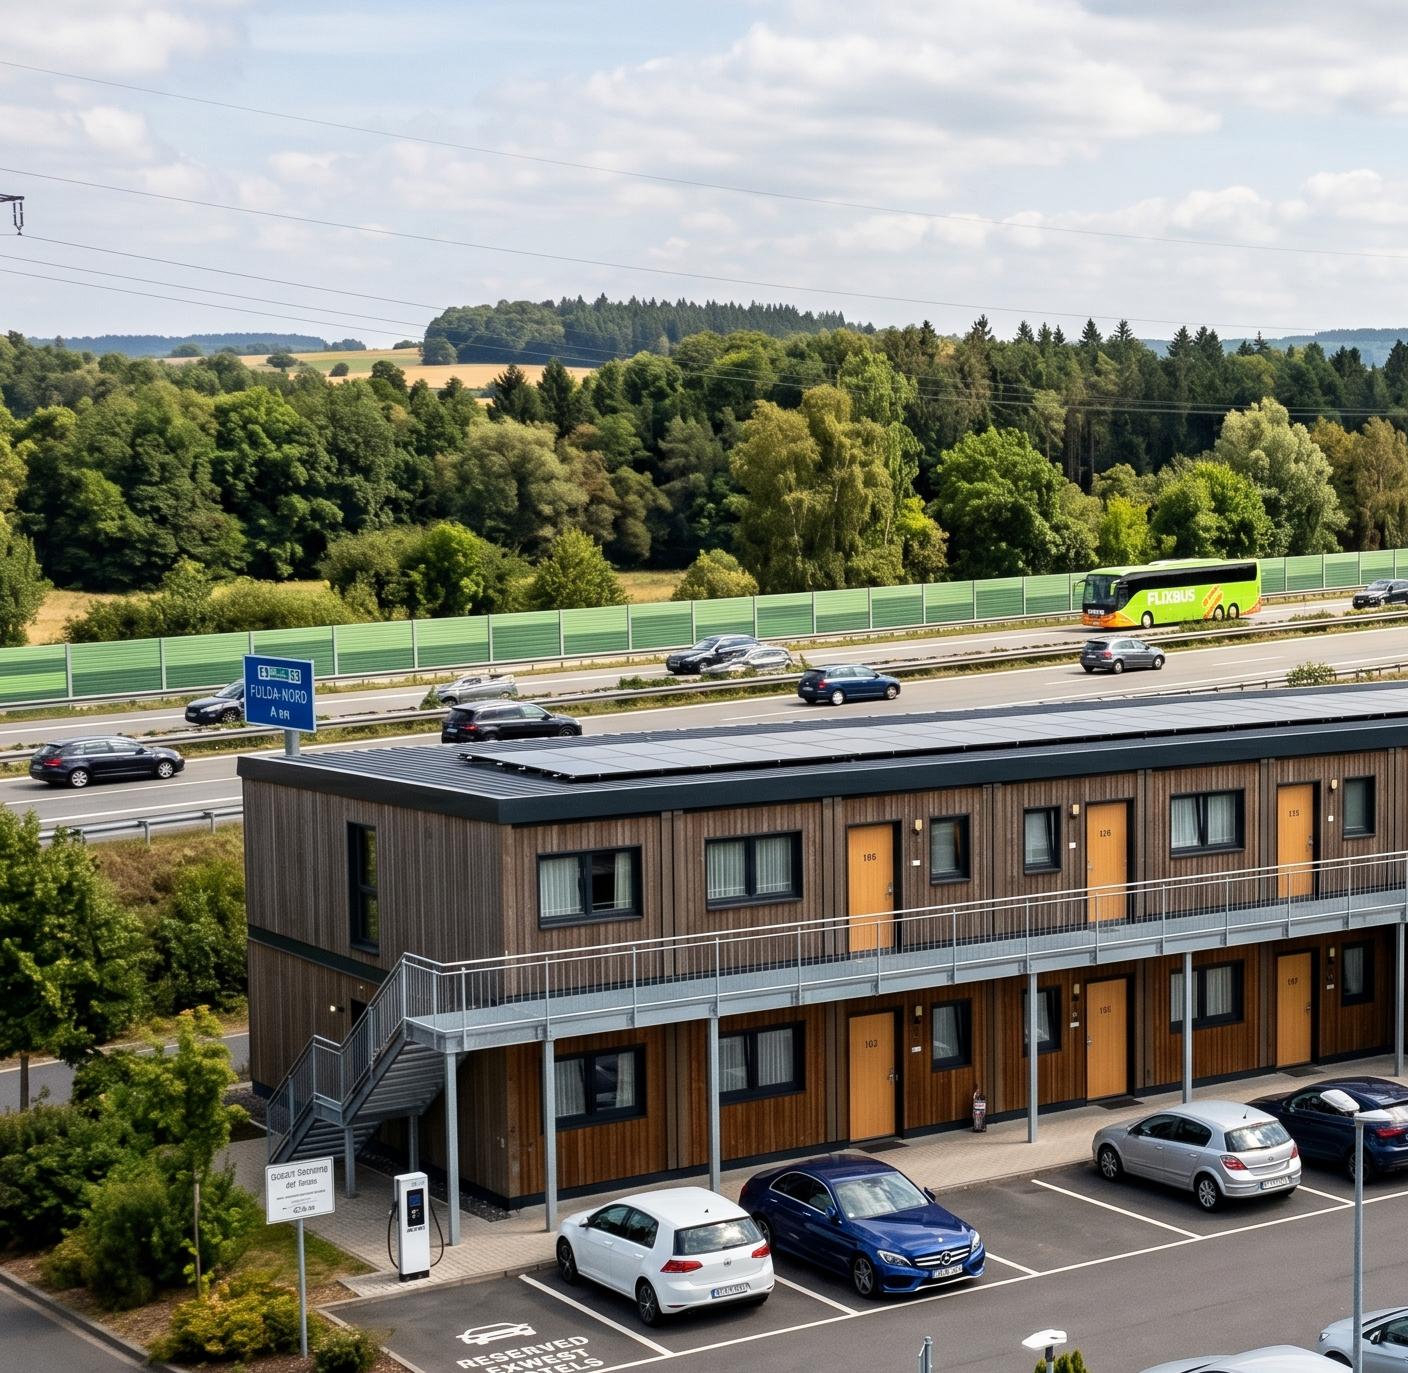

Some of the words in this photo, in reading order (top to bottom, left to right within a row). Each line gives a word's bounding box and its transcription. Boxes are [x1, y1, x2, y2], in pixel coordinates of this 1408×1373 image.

[1147, 588, 1196, 606] FLIXBUS
[250, 684, 308, 704] FULDA-NORD
[456, 1336, 589, 1369] RESERVED
[485, 1348, 590, 1373] EXWEST
[523, 1357, 604, 1373] TELS
